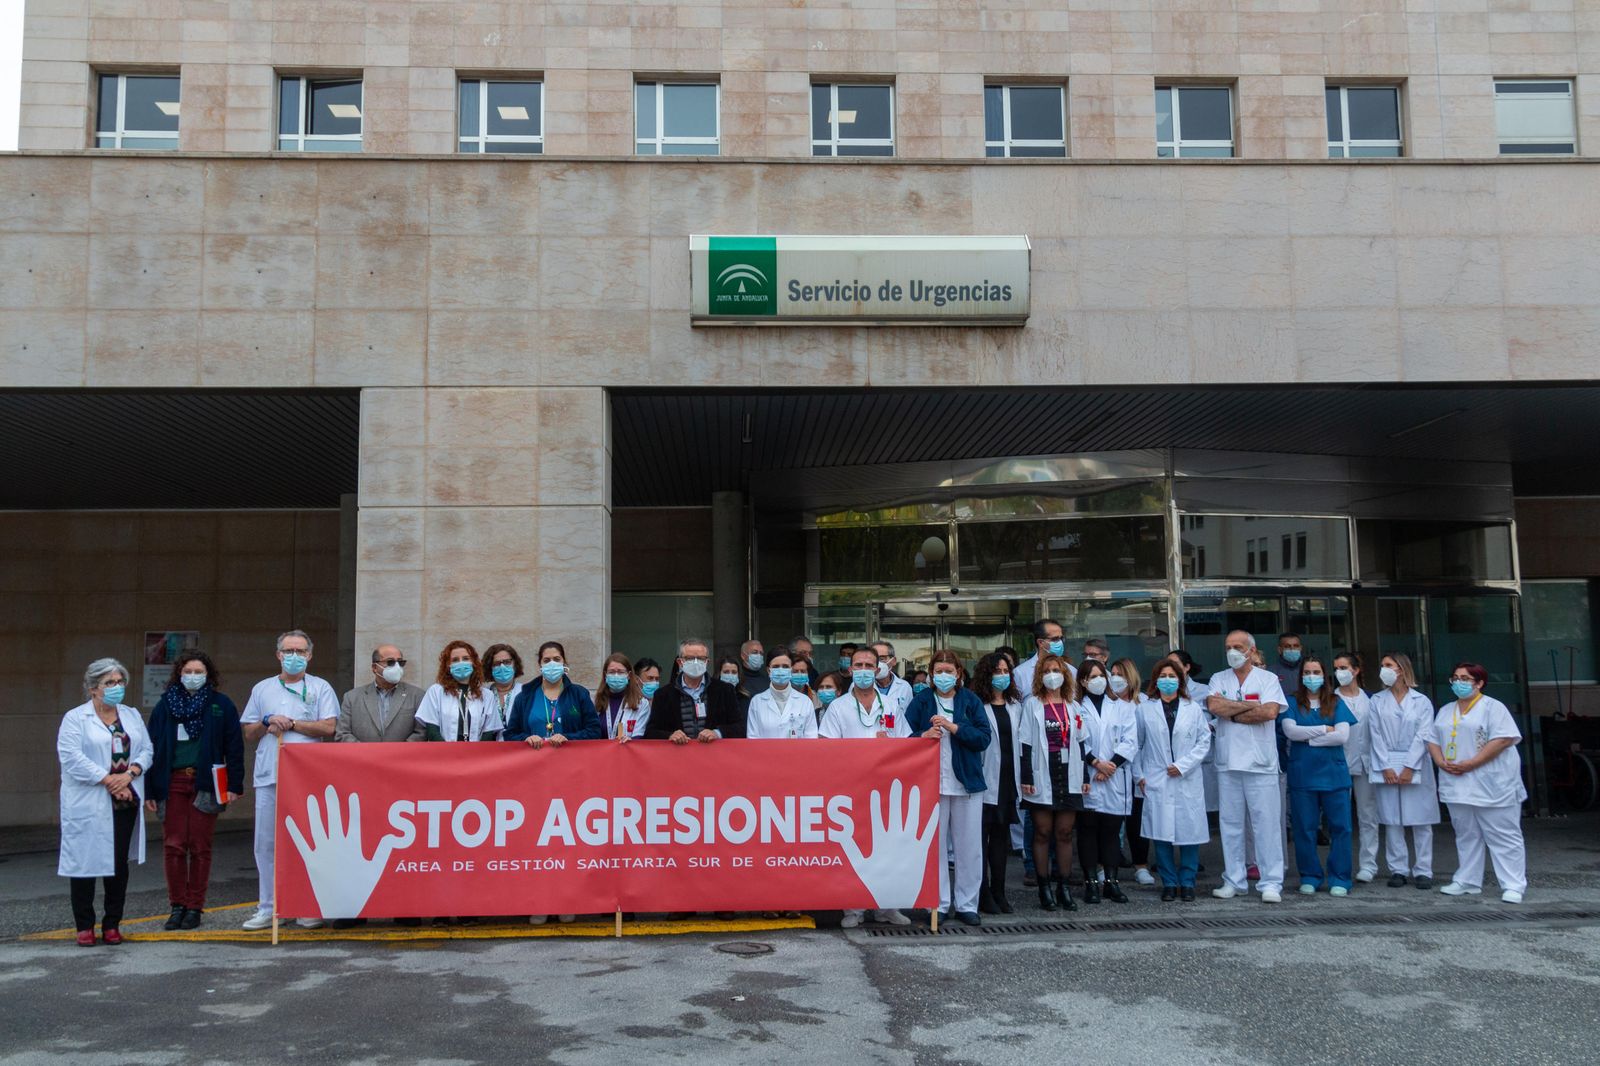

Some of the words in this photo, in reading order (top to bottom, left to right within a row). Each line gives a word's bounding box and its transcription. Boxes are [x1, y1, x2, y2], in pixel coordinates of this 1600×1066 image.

[716, 294, 732, 302] JUNTA
[733, 294, 740, 302] DE
[741, 294, 769, 302] ANDALUCIA
[788, 279, 872, 302] Servicio
[877, 279, 903, 302] de
[909, 279, 1013, 308] Urgencias
[387, 798, 526, 849] STOP
[536, 794, 855, 847] AGRESIONES
[395, 859, 442, 873] ÁREA
[452, 860, 475, 872] DE
[486, 857, 566, 872] GESTIÓN
[576, 856, 677, 871] SANITARIA
[687, 856, 721, 868] SUR
[732, 856, 754, 868] DE
[764, 855, 843, 867] GRANADA
